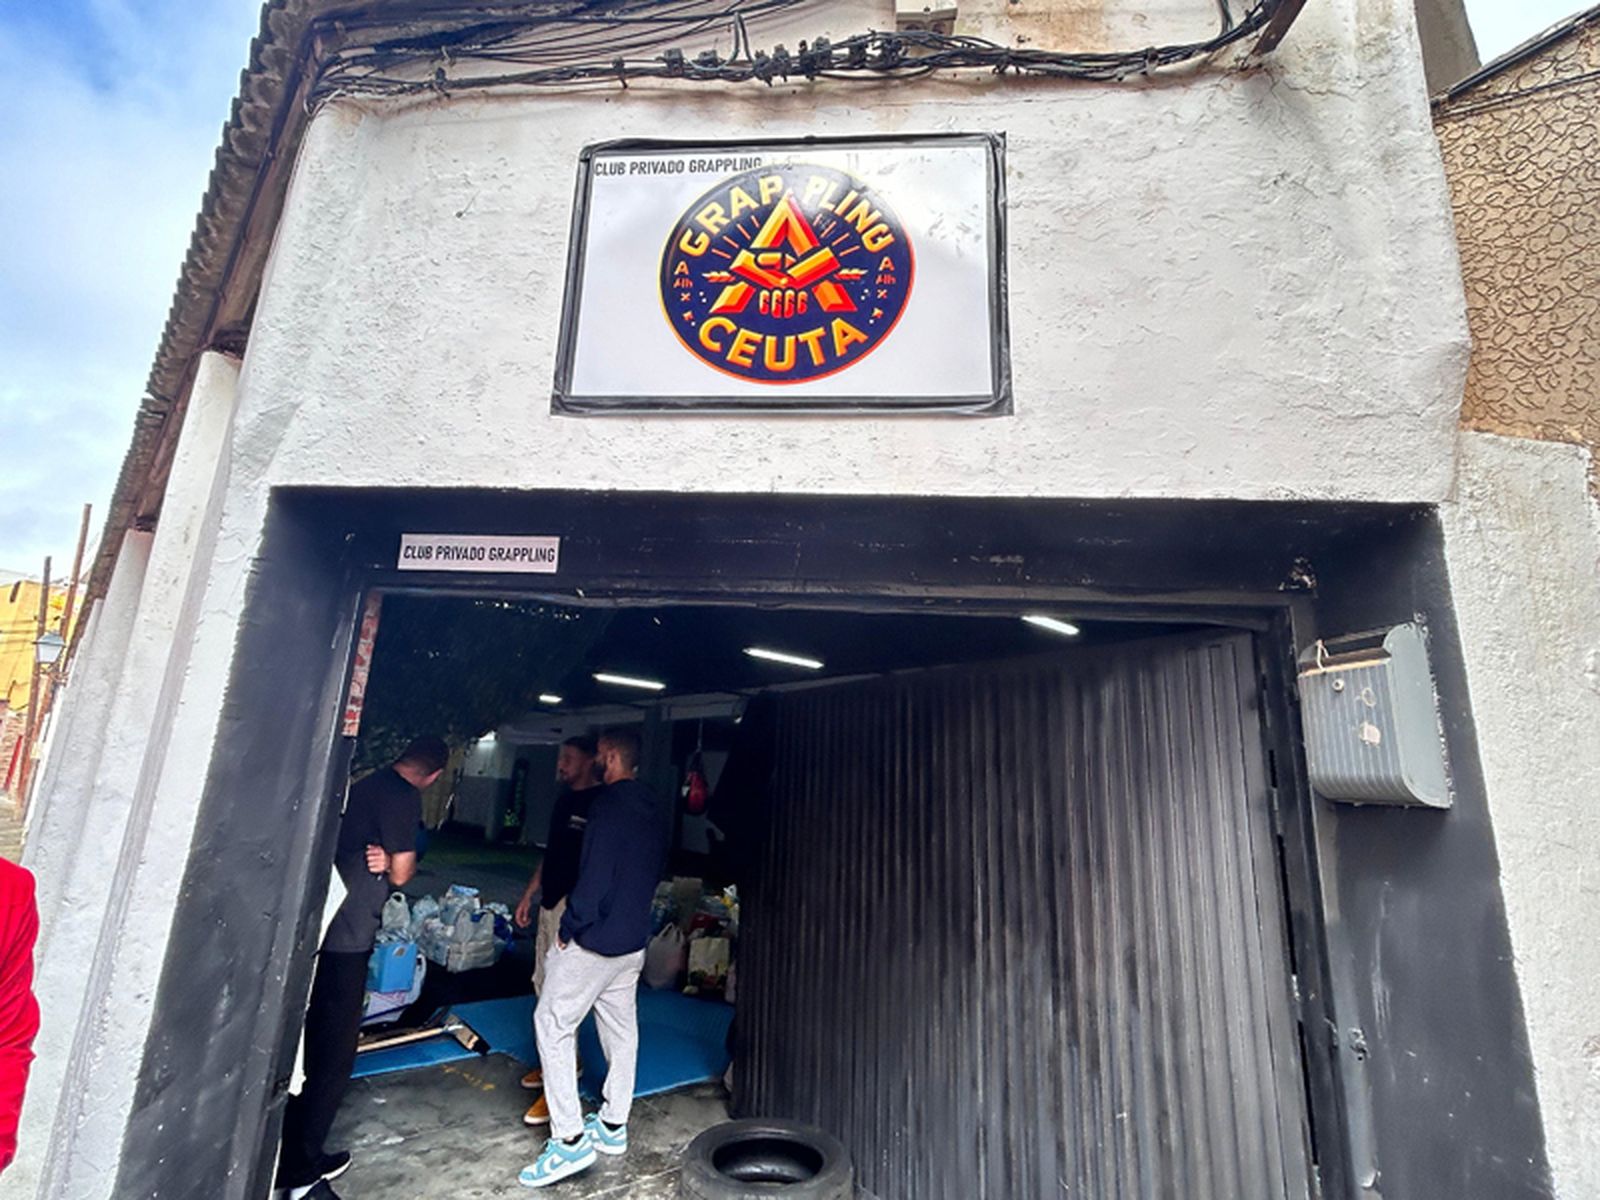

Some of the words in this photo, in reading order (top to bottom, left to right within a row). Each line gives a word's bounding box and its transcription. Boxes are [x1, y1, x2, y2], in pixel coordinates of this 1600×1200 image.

[594, 162, 626, 177] CLUB
[629, 160, 685, 175] PRIVADO
[698, 316, 869, 372] CEUTA
[403, 545, 433, 560] CLUB
[435, 546, 485, 561] PRIVADO
[488, 547, 555, 563] GRAPPLING
